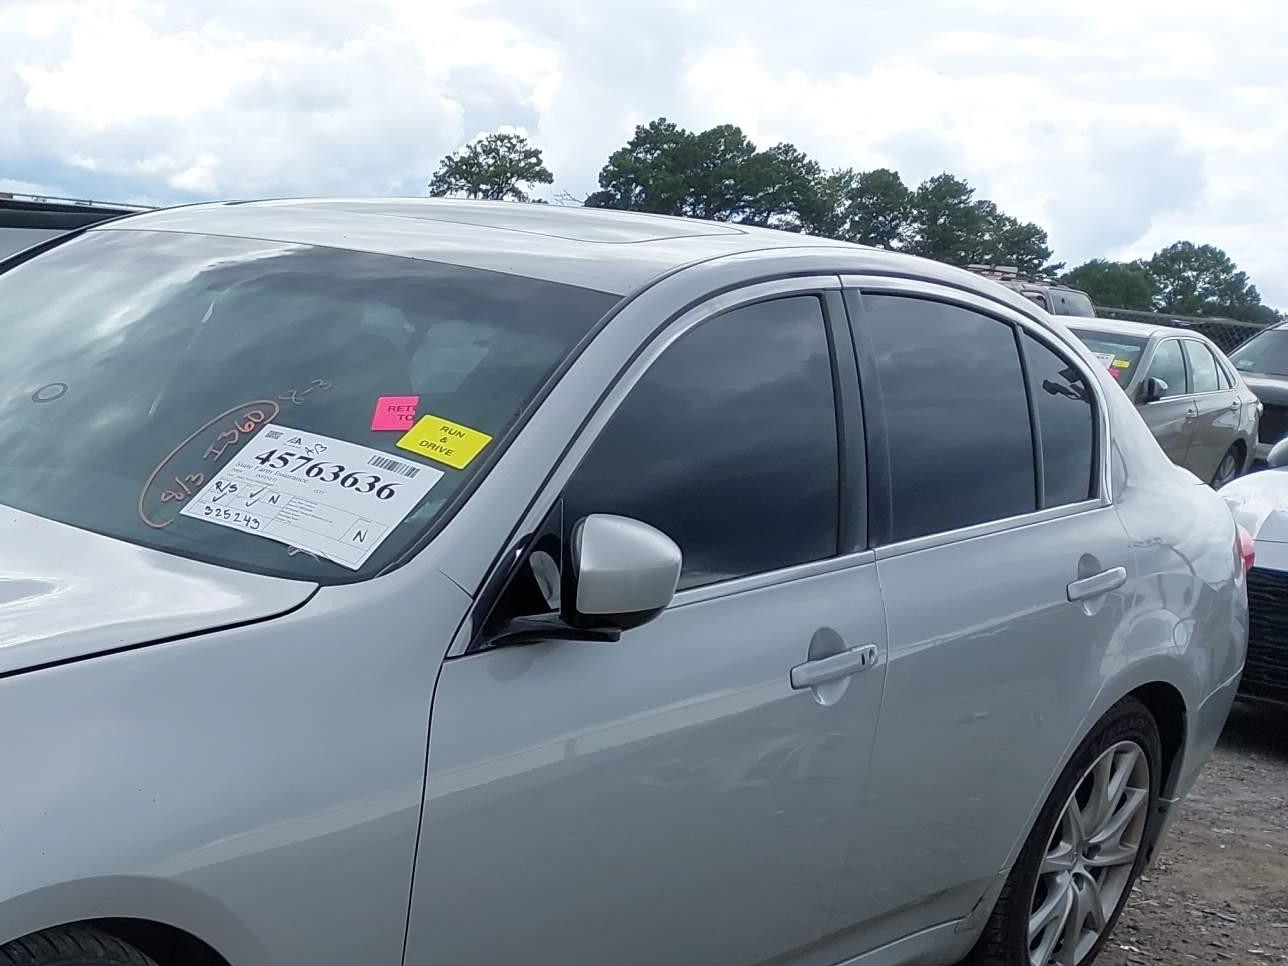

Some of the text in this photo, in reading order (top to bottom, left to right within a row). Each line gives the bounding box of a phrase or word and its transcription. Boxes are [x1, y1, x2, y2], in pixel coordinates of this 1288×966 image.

[439, 425, 466, 439] RUN
[419, 440, 455, 456] DRIVE
[255, 448, 404, 500] 45763636
[352, 529, 368, 543] N
